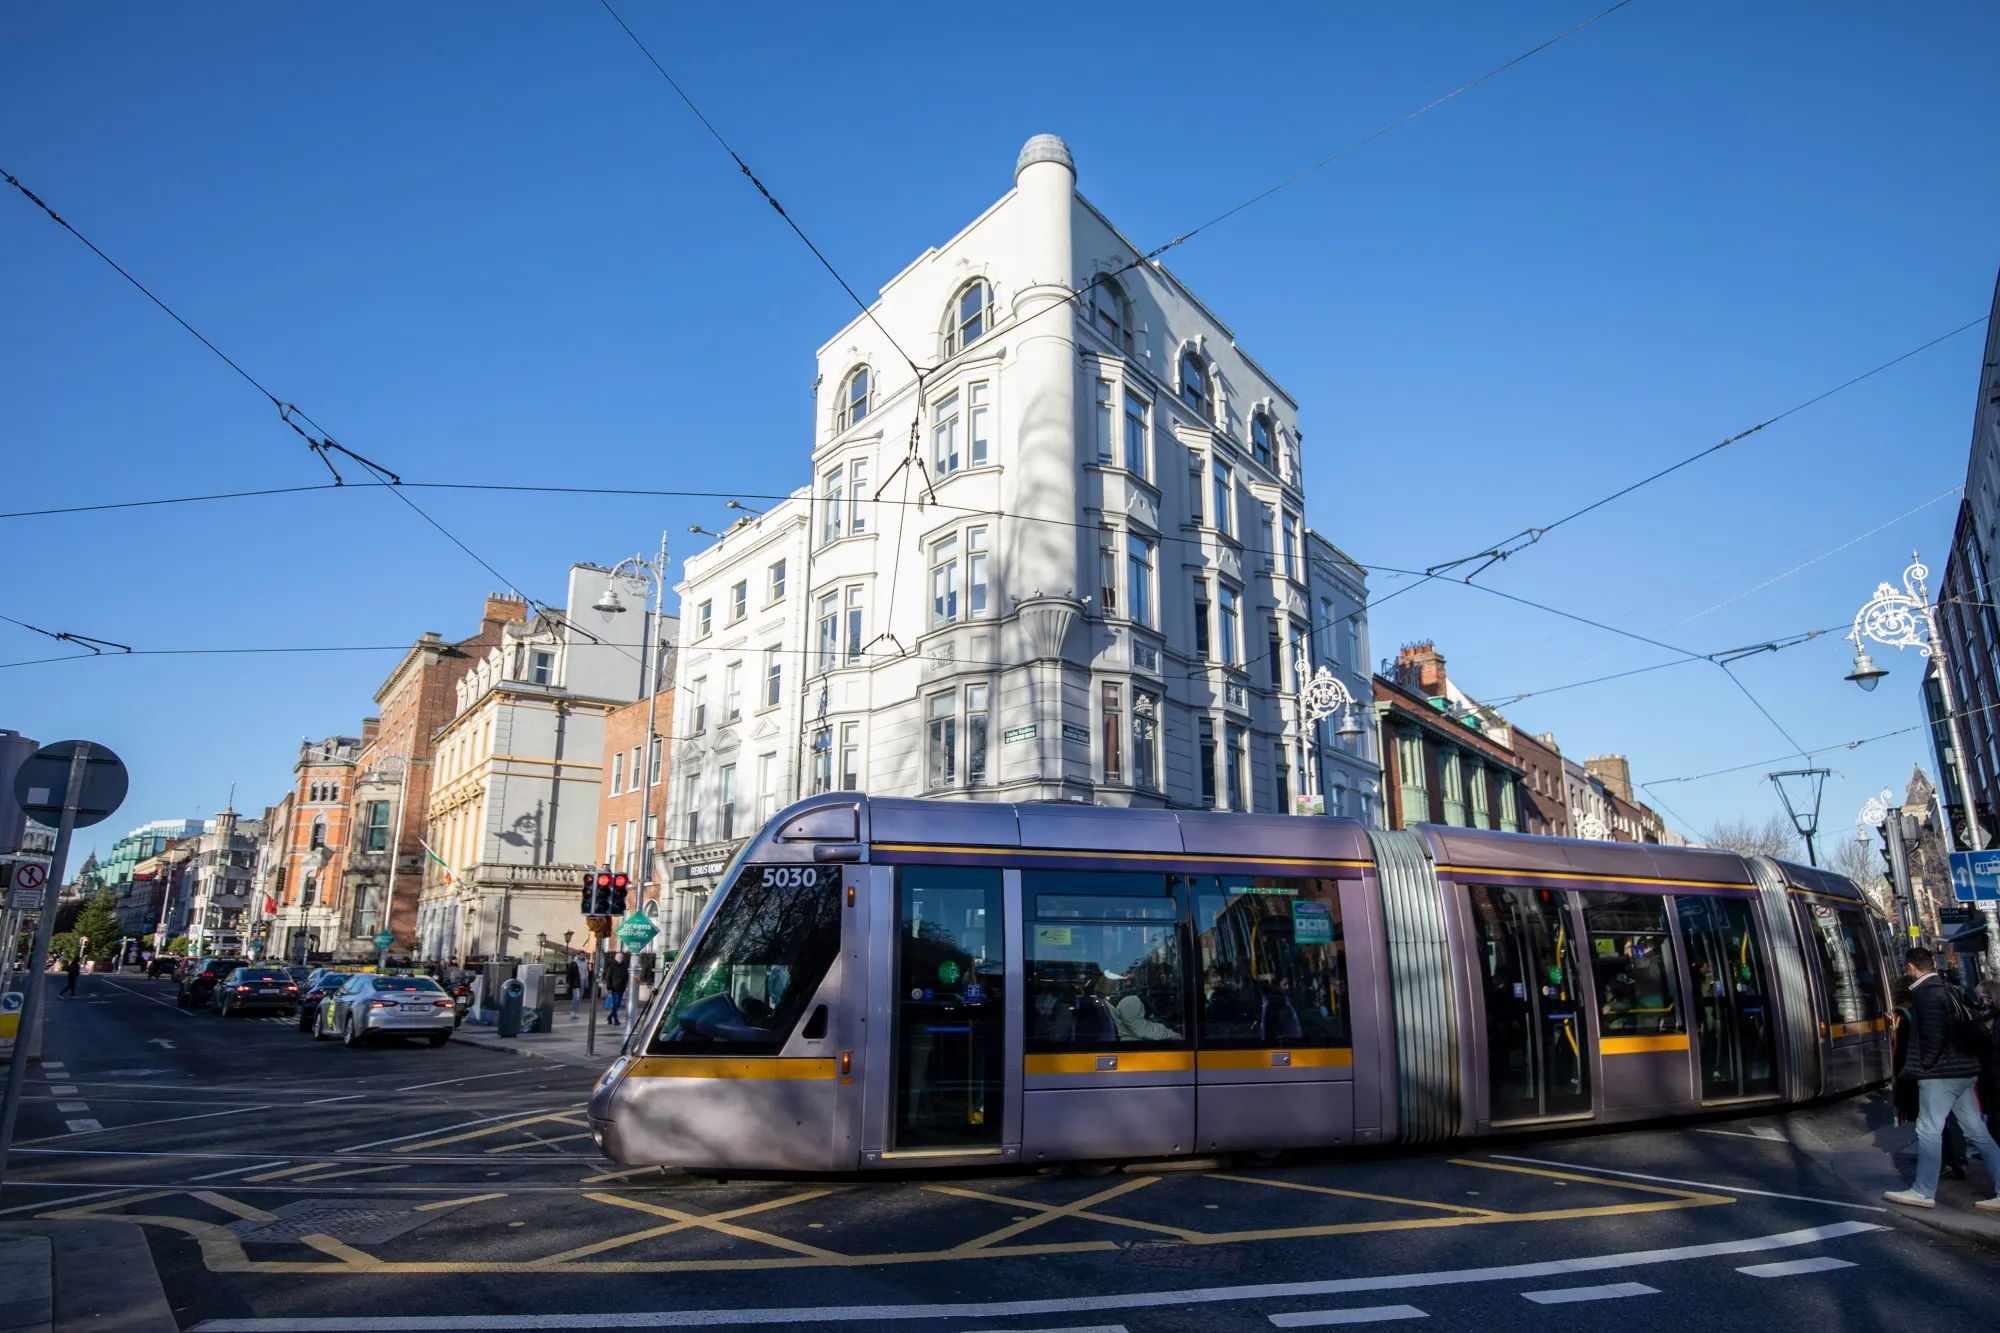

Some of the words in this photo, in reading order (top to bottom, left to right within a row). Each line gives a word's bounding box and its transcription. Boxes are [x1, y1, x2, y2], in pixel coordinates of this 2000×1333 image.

[690, 864, 708, 876] REMUS
[761, 868, 817, 887] 5030
[623, 923, 652, 932] greens
